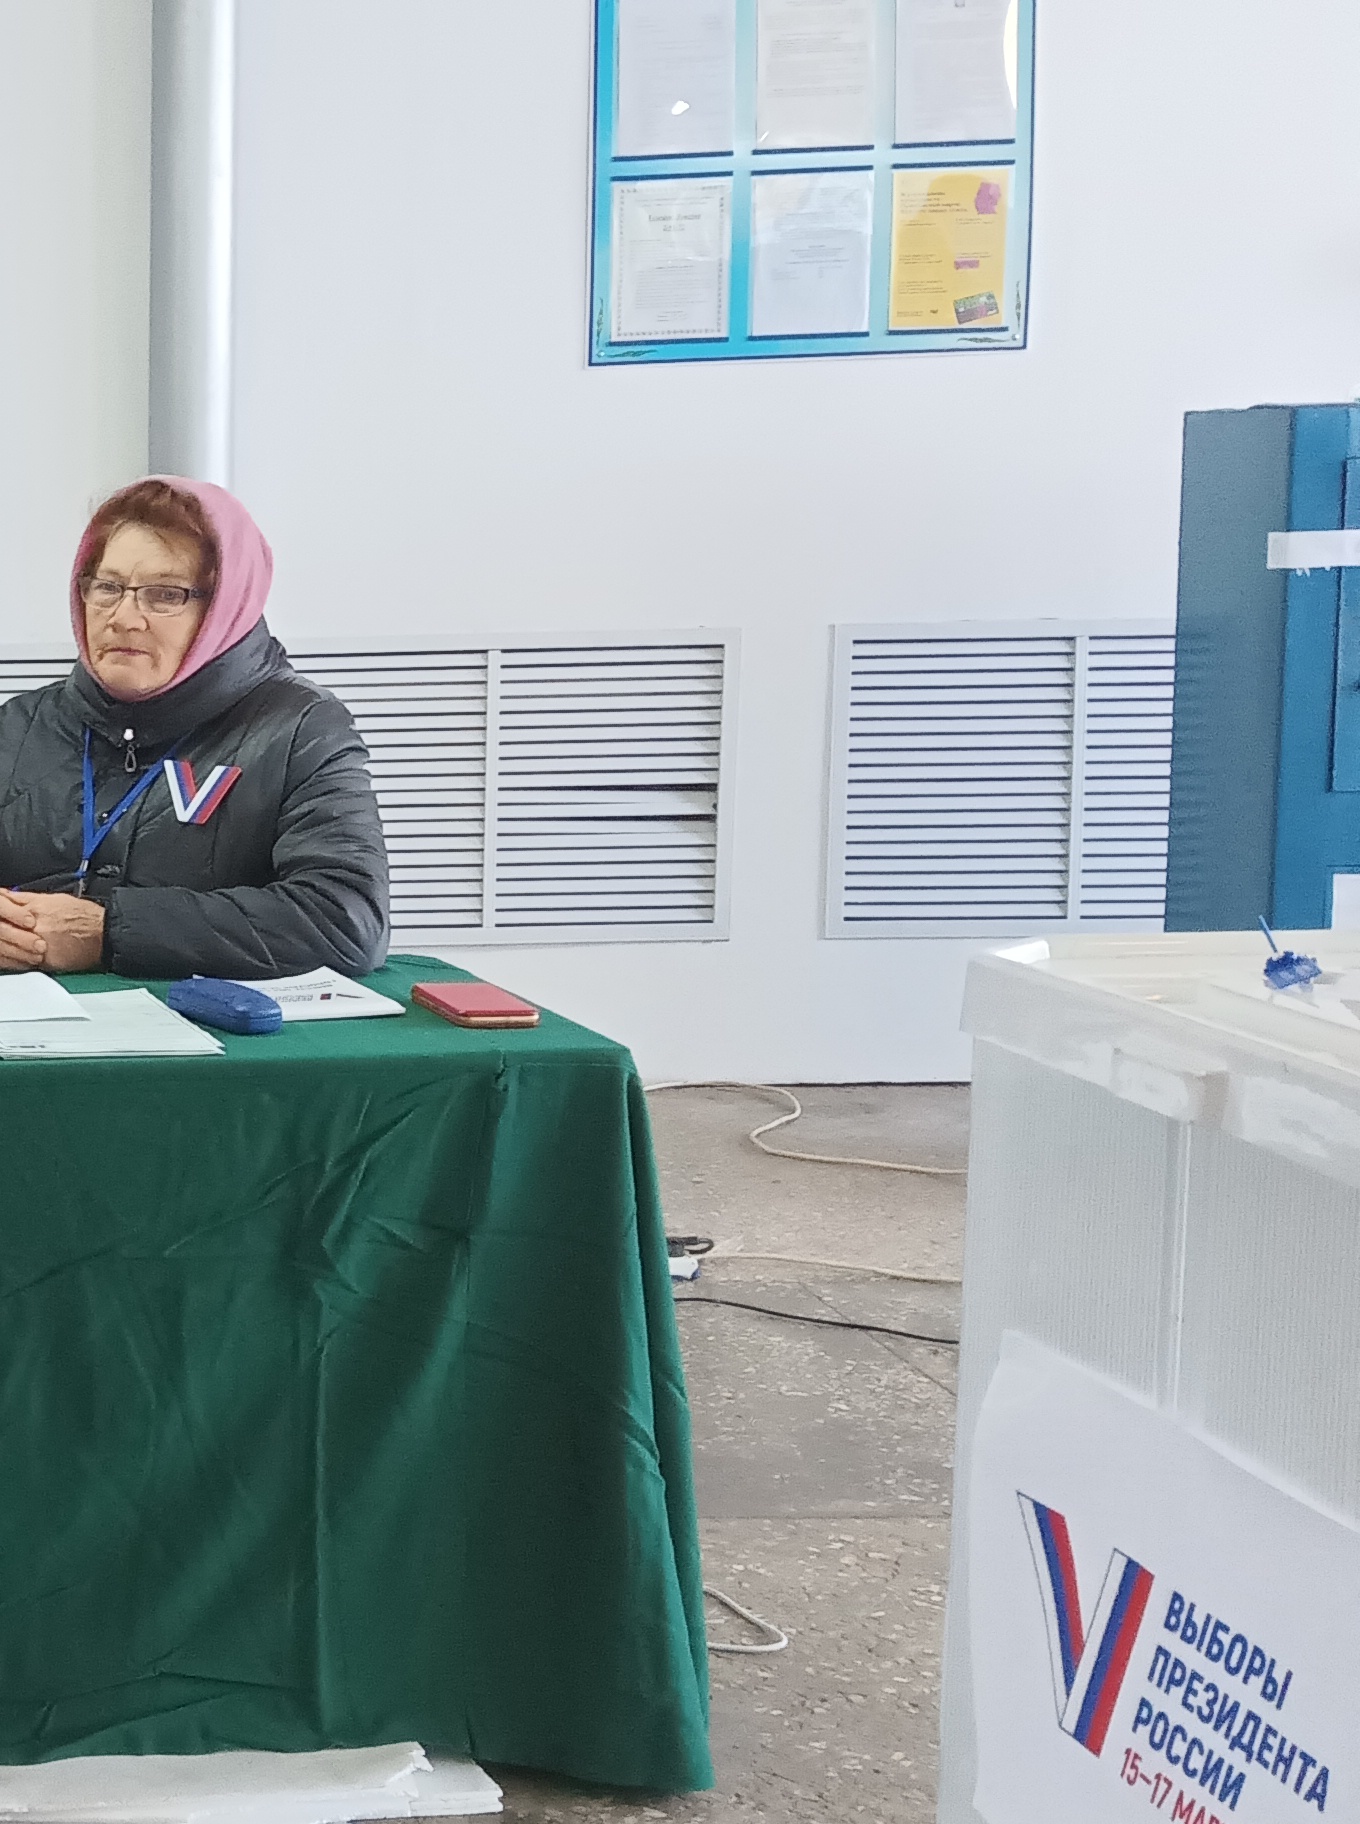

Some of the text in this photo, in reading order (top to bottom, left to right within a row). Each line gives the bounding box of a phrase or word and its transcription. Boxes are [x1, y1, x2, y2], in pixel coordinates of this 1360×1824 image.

[1163, 1590, 1293, 1710] ВЫБОРЫ
[1131, 1696, 1246, 1812] РОССИИ
[1147, 1644, 1330, 1813] ПРЕЗИДЕНТА
